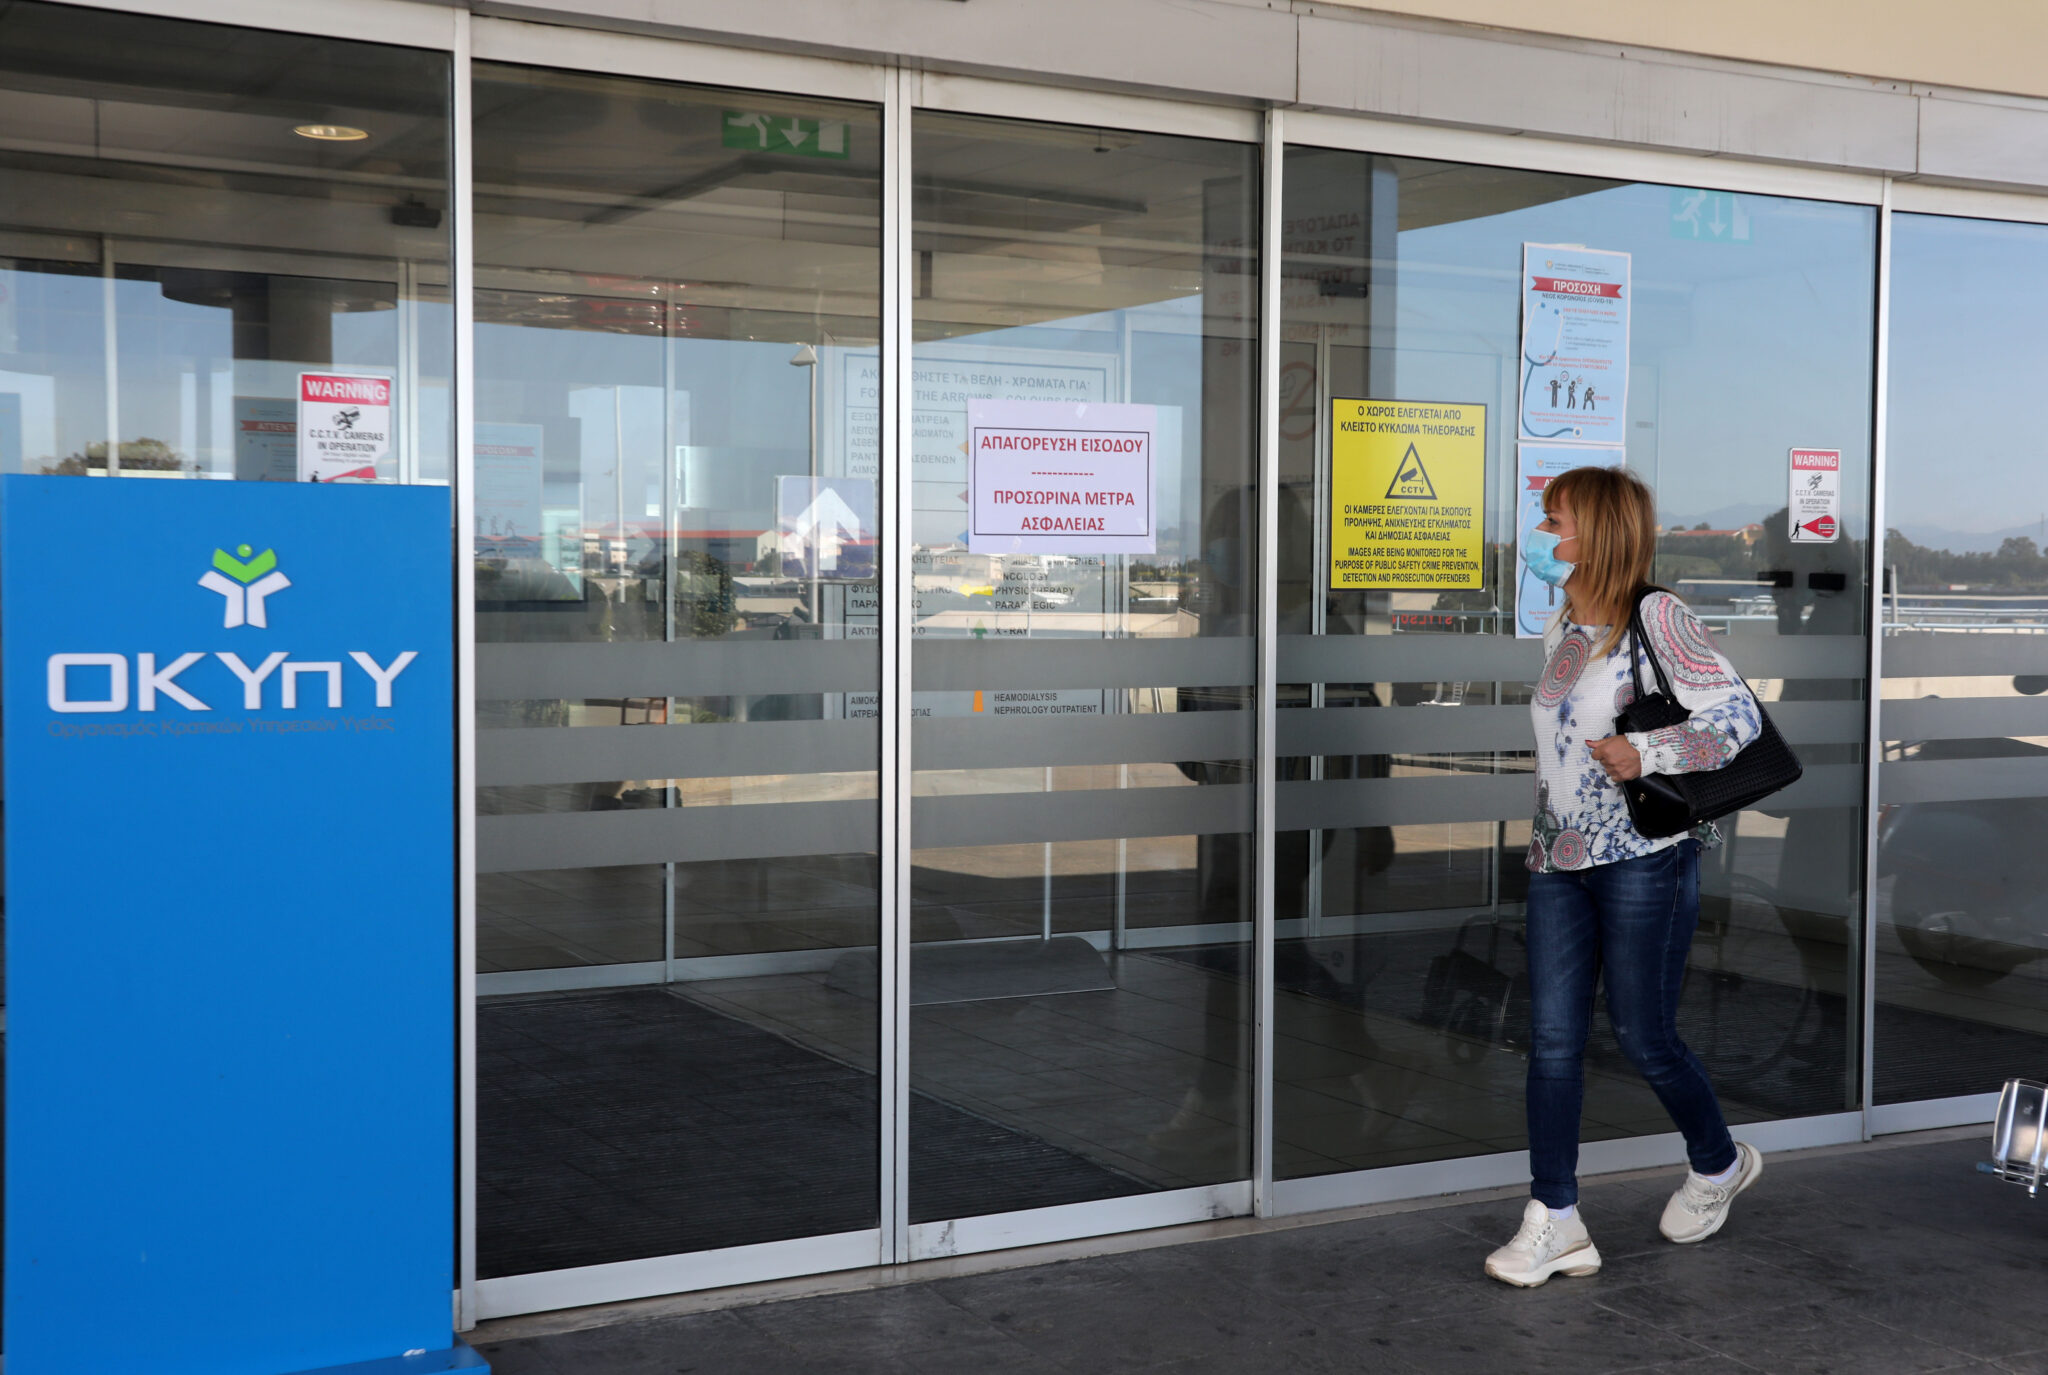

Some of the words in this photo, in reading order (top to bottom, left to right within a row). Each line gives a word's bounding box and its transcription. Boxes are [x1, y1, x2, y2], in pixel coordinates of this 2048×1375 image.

[1553, 280, 1601, 294] ΠΡΟΣΟΧΗ
[970, 374, 1002, 386] ΒΕΛΗ
[1012, 377, 1066, 390] ΧΡΩΜΑΤΑ
[306, 380, 387, 400] WARNING
[1358, 405, 1365, 416] Ο
[1366, 405, 1395, 417] ΧΩΡΟΣ
[1398, 407, 1442, 419] ΕΛΕΓΧΕΤΑΙ
[1443, 409, 1462, 420] ΑΠΟ
[1341, 421, 1377, 433] ΚΛΕΙΣΤΟ
[1378, 422, 1420, 434] ΚΥΚΛΩΜΑ
[1423, 424, 1476, 437] ΤΗΛΕΟΡΑΣΗΣ
[344, 431, 384, 441] CAMERAS
[318, 441, 327, 450] IN
[329, 442, 376, 452] OPERATION
[981, 436, 1077, 451] ΑΠΑΓΟΡΕΥΣΗ
[1081, 438, 1143, 453] ΕΙΣΟΔΟΥ
[1794, 454, 1837, 467] WARNING
[1401, 486, 1425, 494] CCTV
[994, 490, 1081, 505] ΠΡΟΣΩΡΙΝΑ
[1085, 492, 1135, 506] ΜΕΤΡΑ
[1344, 504, 1351, 514] ΟΙ
[1353, 505, 1385, 514] ΚΑΜΕΡΕΣ
[1387, 505, 1428, 515] ΕΛΕΓΧΟΝΤΑΙ
[1429, 506, 1440, 516] ΓΙΑ
[1441, 506, 1472, 517] ΣΚΟΠΟΥΣ
[1021, 516, 1105, 531] ΑΣΦΑΛΕΙΑΣ
[1344, 517, 1383, 528] ΠΡΟΛΗΨΗΣ,
[1385, 518, 1426, 528] ΑΝΙΧΝΕΥΣΗΣ
[1428, 519, 1471, 529] ΕΓΚΛΗΜΑΤΟΣ
[1365, 531, 1376, 540] ΚΑΙ
[1378, 531, 1412, 541] ΔΗΜΟΣΙΑΣ
[1413, 531, 1450, 541] ΑΣΦΑΛΕΙΑΣ
[1348, 548, 1371, 557] IMAGES
[1373, 548, 1384, 557] ARE
[1386, 548, 1405, 557] BEING
[1406, 548, 1441, 558] MONITORED
[1442, 548, 1454, 558] FOR
[1456, 548, 1467, 558] THE
[1335, 560, 1364, 570] PURPOSE
[1365, 560, 1374, 570] OF
[1375, 560, 1396, 570] PUBLIC
[1398, 561, 1421, 570] SAFETY
[1422, 561, 1441, 570] CRIME
[1343, 573, 1377, 582] DETECTION
[1378, 573, 1390, 582] AND
[1392, 573, 1435, 583] PROSECUTION
[1436, 573, 1470, 583] OFFENDERS
[994, 692, 1058, 702] HEAMODIALYSIS
[994, 705, 1048, 715] NEPHROLOGY
[1050, 704, 1097, 714] OUTPATIENT
[49, 719, 157, 738] Οργανισμός
[161, 718, 244, 736] Κρατικών
[247, 715, 339, 735] Υπηρεσιών
[341, 714, 395, 732] Υγείας
